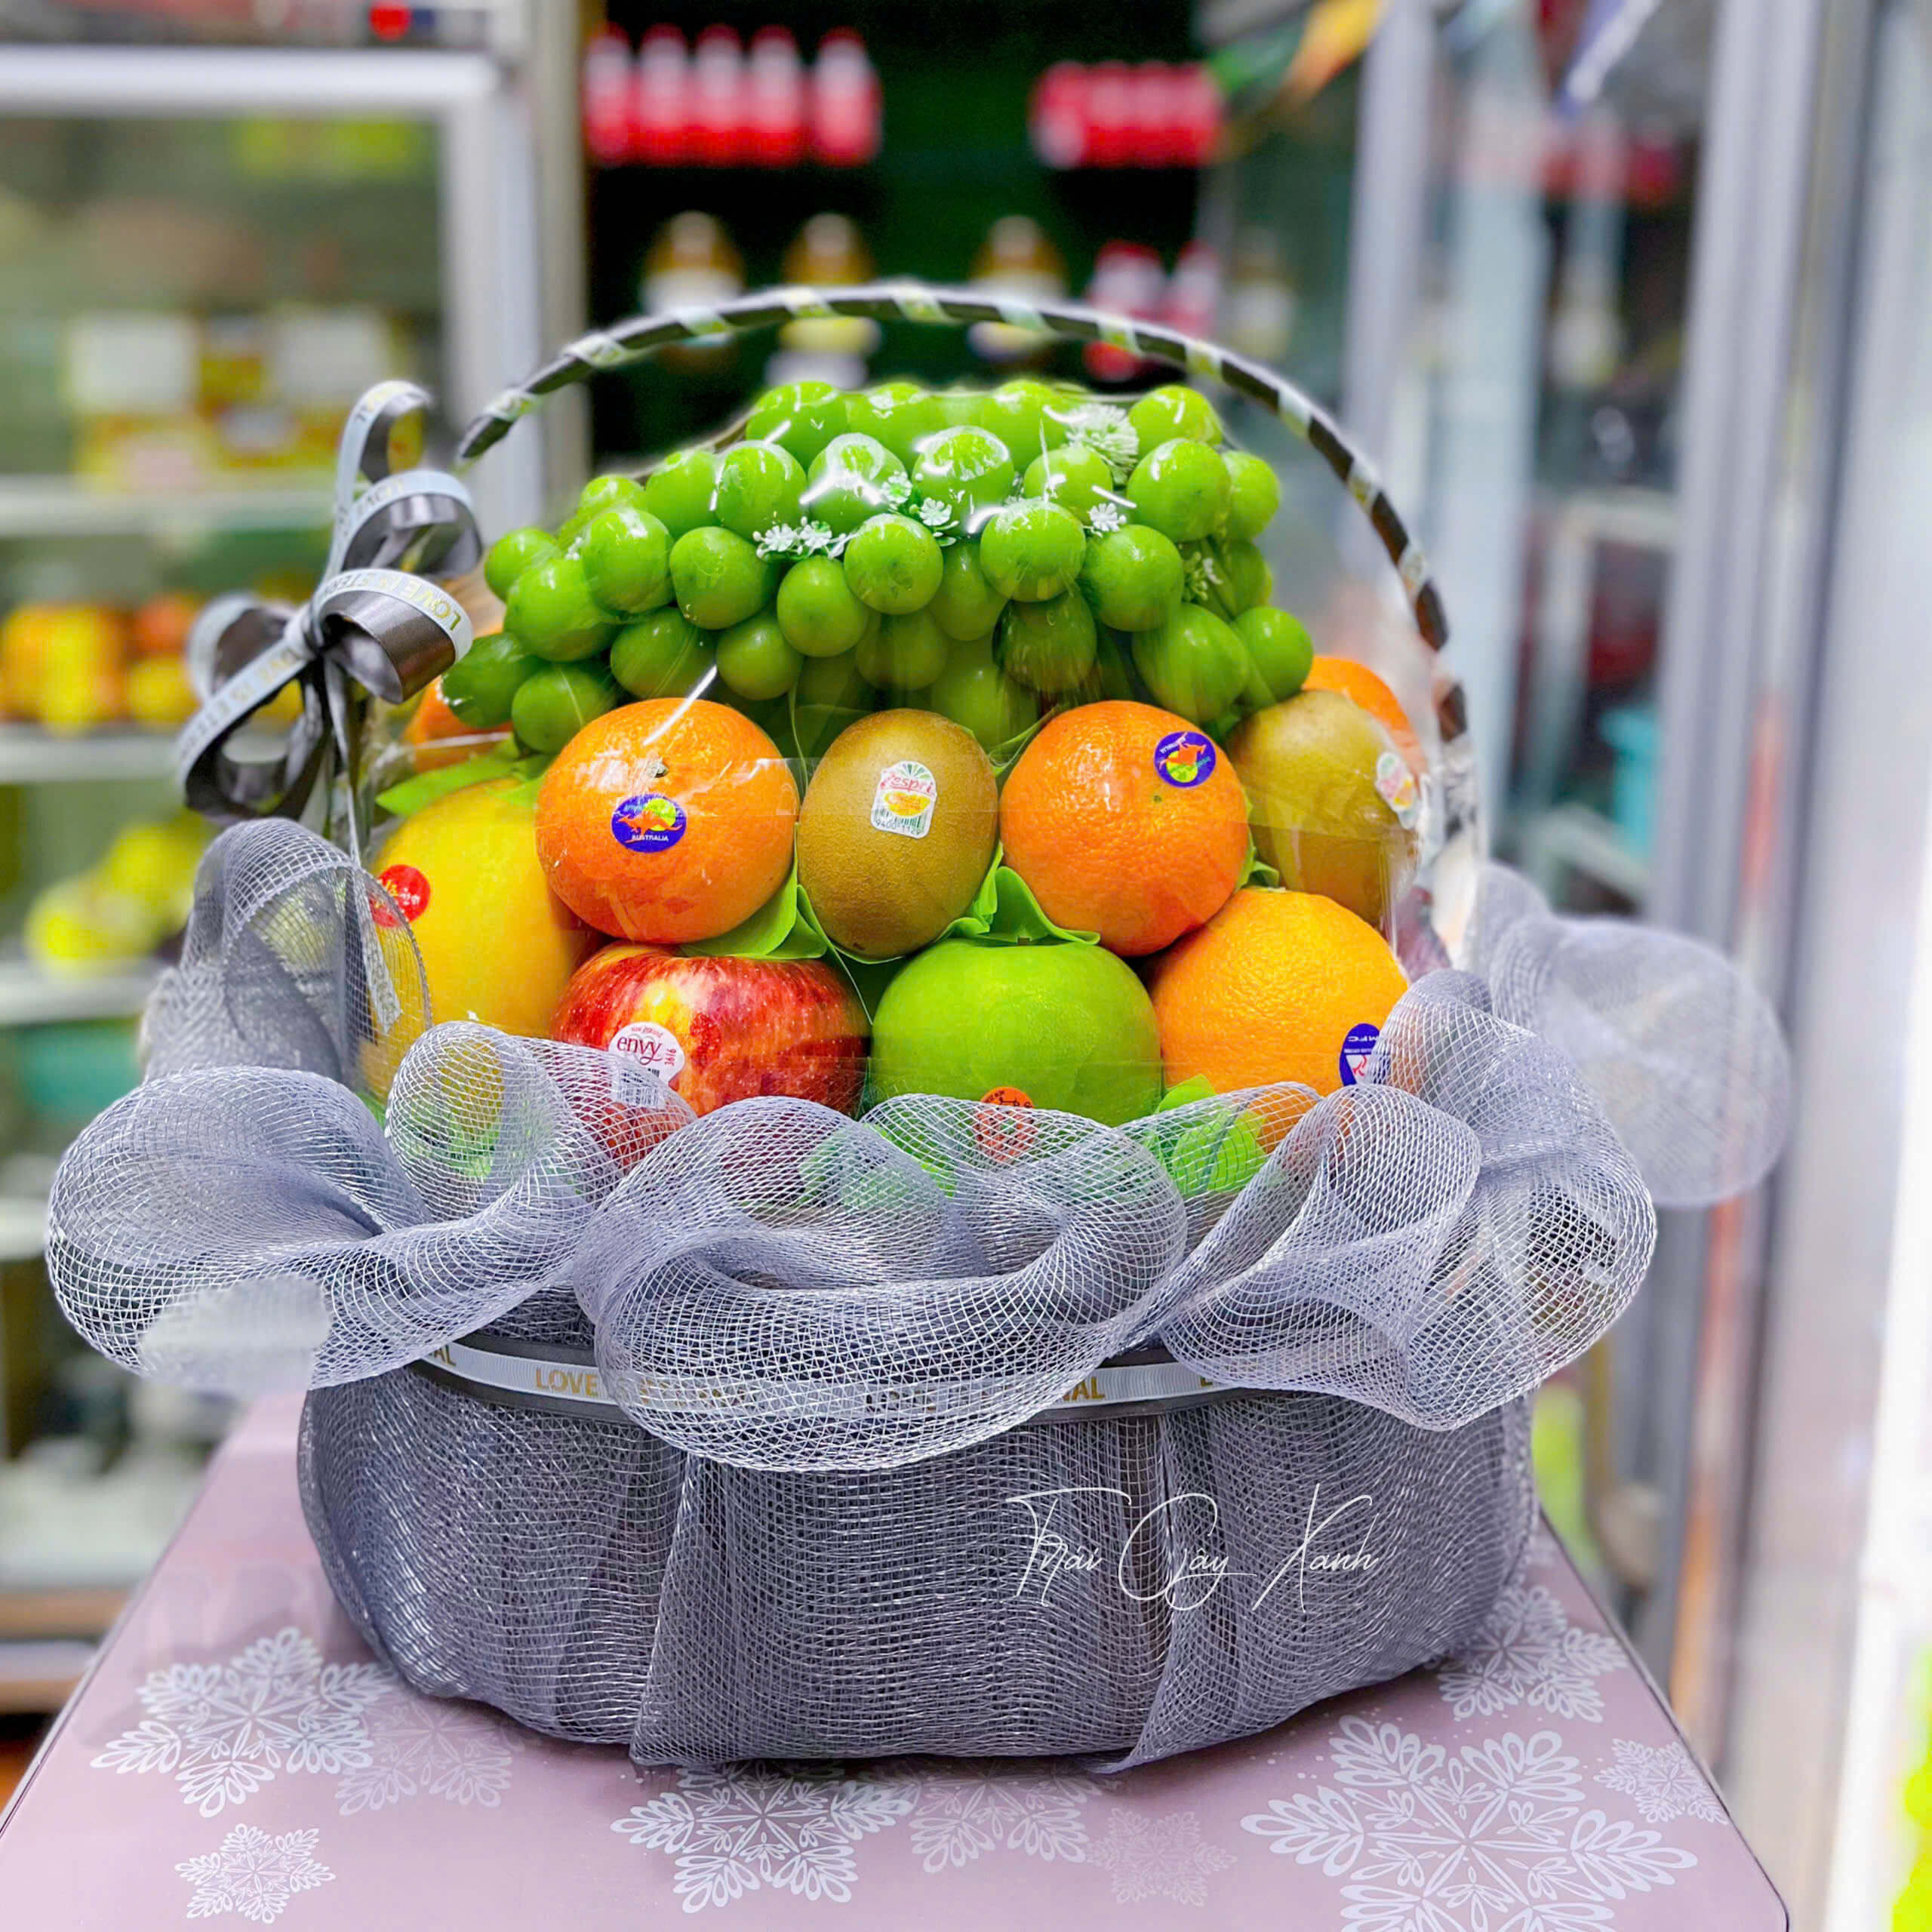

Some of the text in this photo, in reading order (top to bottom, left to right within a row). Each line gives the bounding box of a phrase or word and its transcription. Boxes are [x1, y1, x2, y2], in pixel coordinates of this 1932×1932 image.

[401, 579, 462, 631] LOVE
[617, 1036, 663, 1066] envy
[535, 1368, 598, 1397] LOVE
